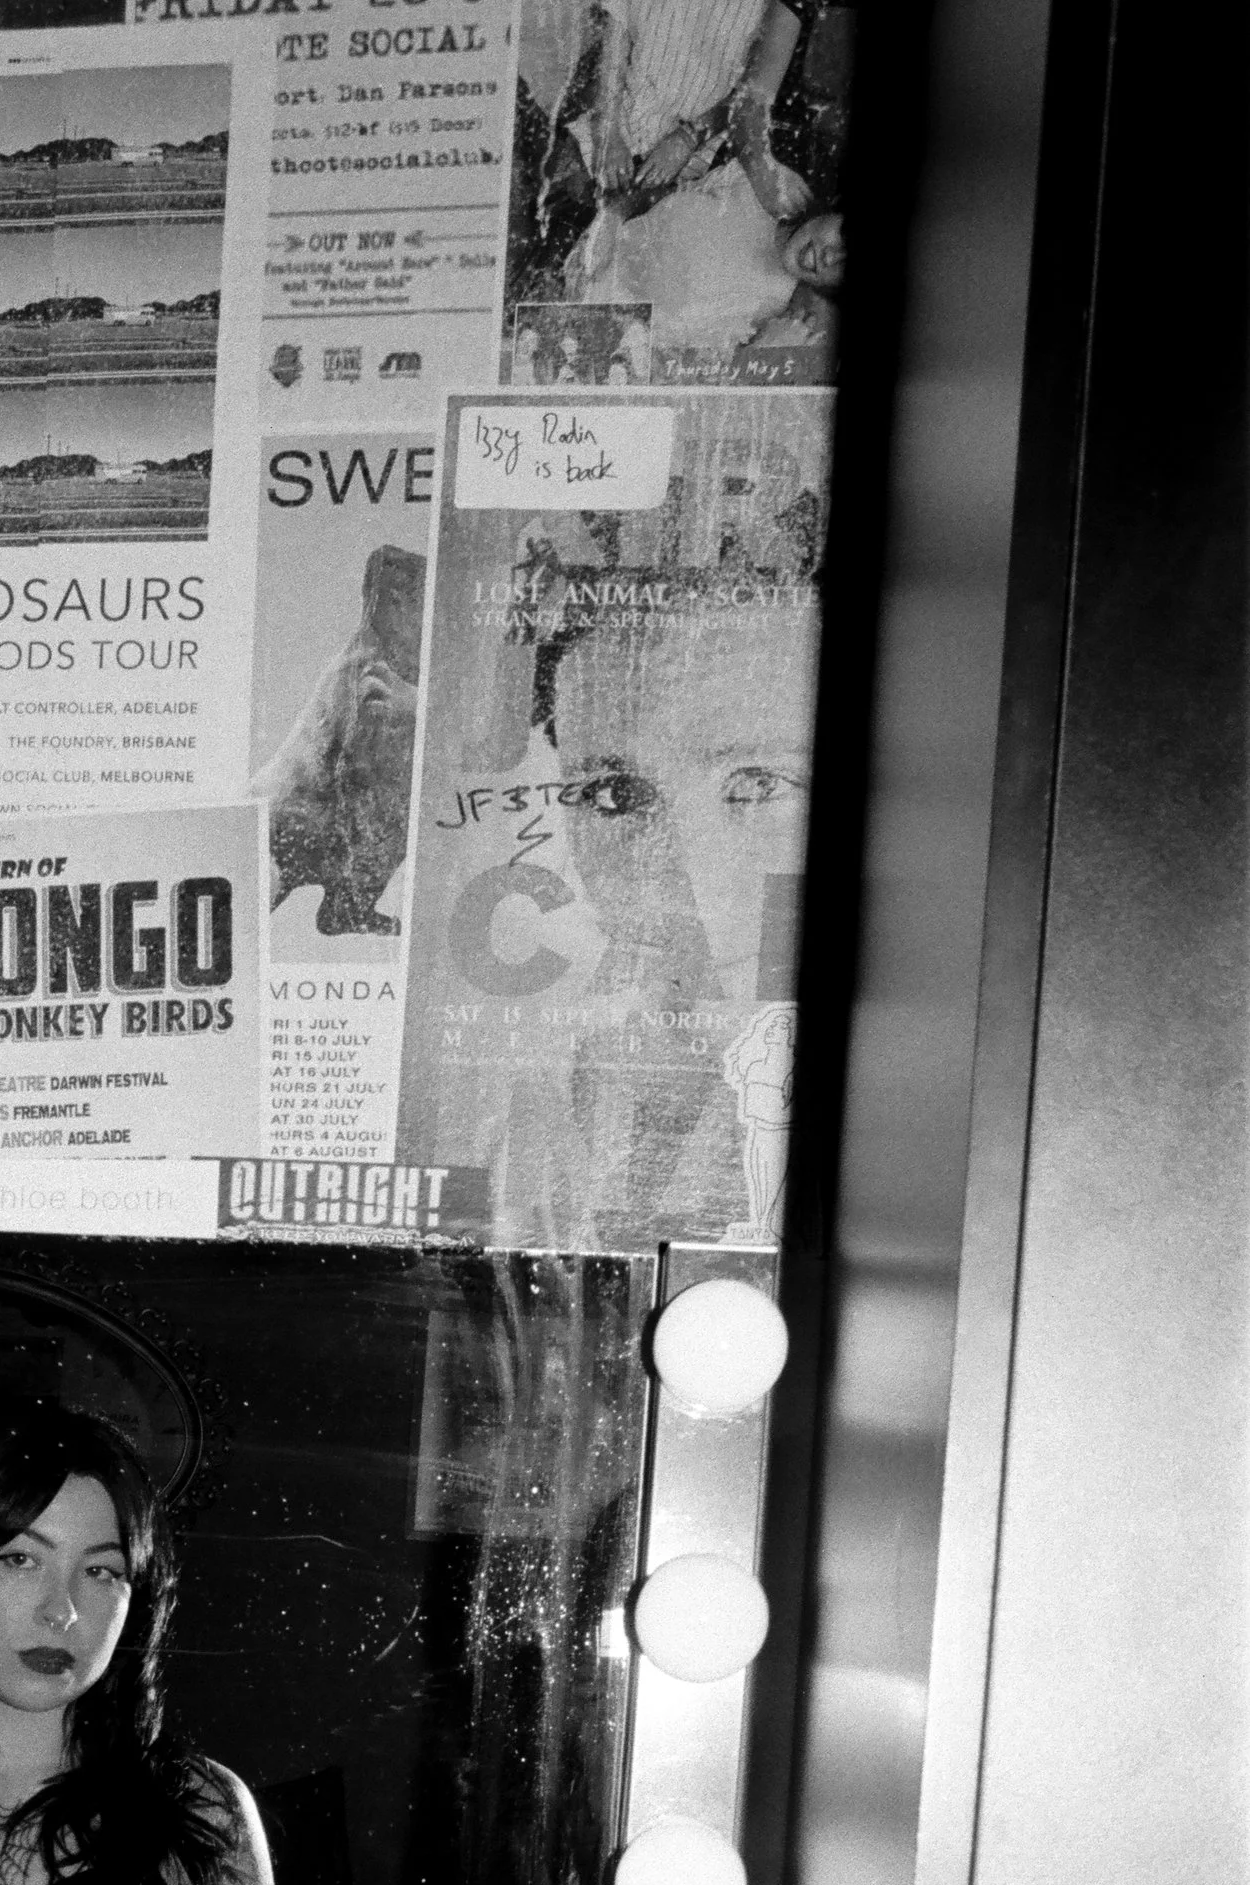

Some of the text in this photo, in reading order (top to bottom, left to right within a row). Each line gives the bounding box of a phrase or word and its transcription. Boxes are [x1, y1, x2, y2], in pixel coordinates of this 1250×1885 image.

[275, 25, 486, 61] TE SOCIAL
[338, 79, 498, 103] Dan Parsons
[308, 229, 396, 252] OUT NOW
[666, 359, 740, 382] Thursday
[746, 360, 780, 381] May
[265, 443, 437, 508] SWE
[535, 449, 619, 484] is back
[91, 639, 201, 671] TOUR
[14, 701, 118, 717] CONTROLLER,
[123, 701, 199, 715] ADELAIDE
[8, 735, 37, 749] THE
[122, 735, 198, 749] BRISBANE
[100, 770, 195, 784] MELBOURNE
[35, 855, 70, 879] OF
[269, 980, 397, 1001] MONDA
[120, 996, 236, 1042] BIRDS
[443, 1003, 483, 1024] SAT
[272, 1018, 290, 1031] RI
[309, 1018, 350, 1031] JULY
[272, 1034, 372, 1047] RI 8-10 JULY
[271, 1050, 289, 1062] RI
[317, 1050, 358, 1062] JULY
[50, 1073, 104, 1091] DARWIN
[105, 1071, 169, 1089] FESTIVAL
[272, 1066, 361, 1079] AT 16 JULY
[270, 1082, 387, 1095] HURS 21 JULY
[12, 1102, 92, 1121] FREMANTLE
[271, 1098, 365, 1110] UN 24 JULY
[270, 1114, 360, 1126] AT 30 JULY
[0, 1129, 64, 1149] ANCHOR
[67, 1128, 132, 1147] ADELAIDE
[270, 1130, 388, 1142] HURS 4 AUGU
[270, 1146, 290, 1157] AT
[307, 1146, 379, 1158] AUGUST
[80, 1185, 175, 1211] booth
[229, 1159, 450, 1228] OUTRIGHT
